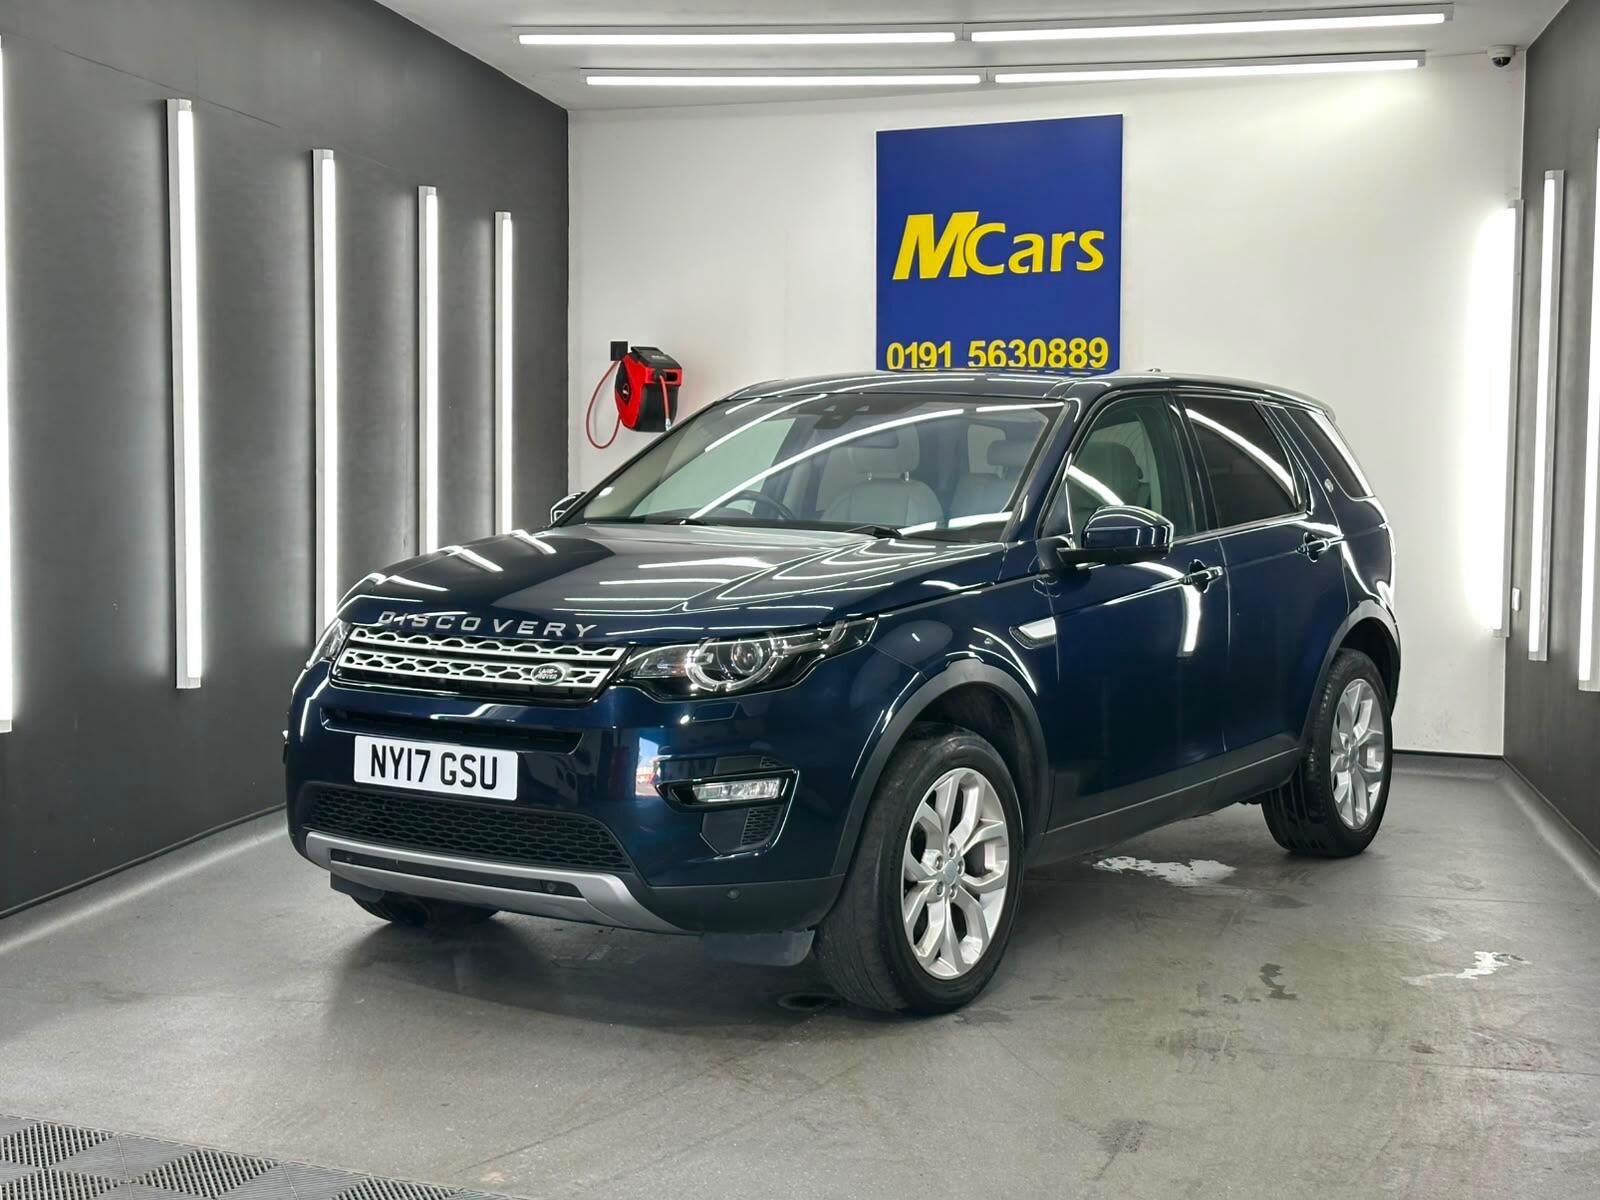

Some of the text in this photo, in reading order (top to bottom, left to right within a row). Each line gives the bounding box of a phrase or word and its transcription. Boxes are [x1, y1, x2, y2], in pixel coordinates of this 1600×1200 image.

[886, 337, 1109, 369] 0191 5630889
[378, 611, 598, 637] DISCOVERY
[370, 744, 498, 790] NY17 GSU
